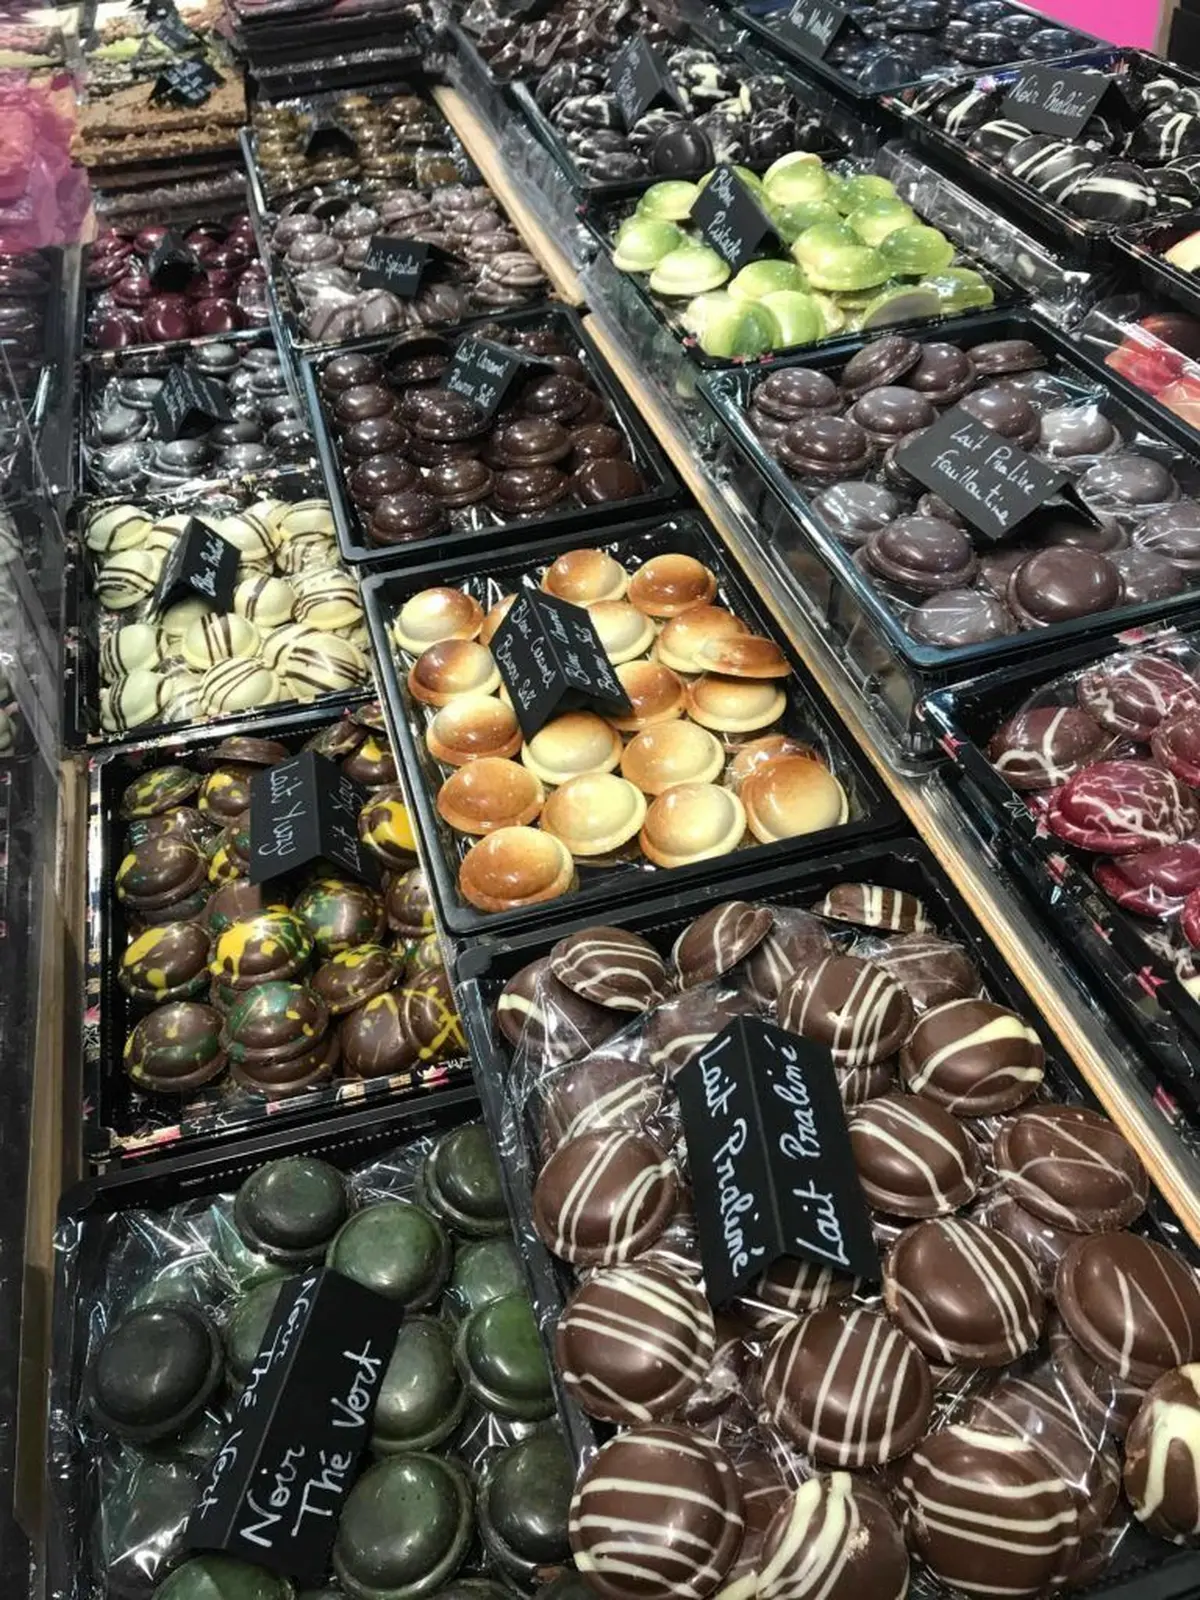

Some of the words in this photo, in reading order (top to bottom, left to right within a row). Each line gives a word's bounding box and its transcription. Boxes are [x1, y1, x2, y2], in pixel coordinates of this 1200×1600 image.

[1009, 74, 1039, 104] Noir
[1041, 80, 1097, 117] Praliné
[710, 169, 735, 208] Blanc
[363, 246, 384, 271] Lait
[707, 210, 742, 264] Pistache
[455, 338, 477, 364] Lait
[931, 449, 1009, 526] Feuillantine
[951, 423, 990, 452] Lait
[984, 446, 1054, 495] Praliné
[511, 598, 532, 639] Blanc
[518, 678, 536, 710] Salé
[270, 761, 303, 804] Lait
[329, 776, 365, 819] Yuzu
[258, 800, 307, 856] Yuzu
[331, 825, 361, 872] Lait
[699, 1036, 736, 1117] Lait
[764, 1034, 821, 1160] Praliné
[713, 1118, 765, 1277] Praliné
[793, 1180, 850, 1265] Lait
[275, 1276, 317, 1363] Noir
[238, 1326, 283, 1410] Thé
[291, 1450, 350, 1537] Thé
[331, 1340, 382, 1427] Vert
[198, 1429, 244, 1520] Vert
[240, 1443, 305, 1548] Noir
